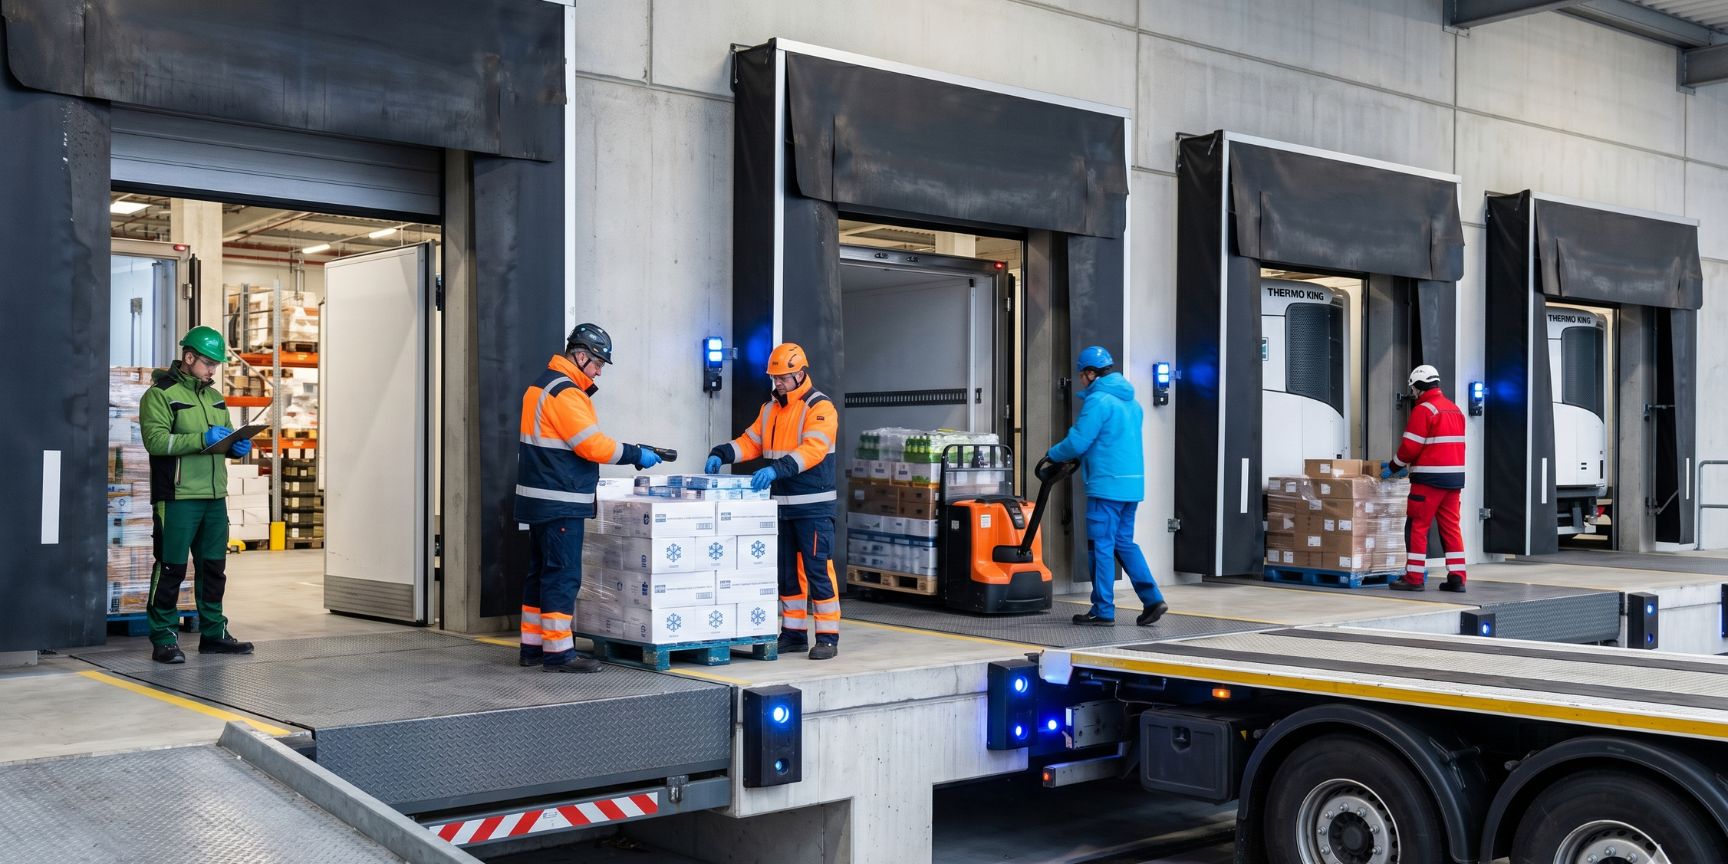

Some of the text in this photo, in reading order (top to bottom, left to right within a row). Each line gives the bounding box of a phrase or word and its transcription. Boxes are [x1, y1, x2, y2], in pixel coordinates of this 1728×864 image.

[1267, 287, 1324, 300] THERMO KING
[1548, 314, 1591, 324] THERMO KING
